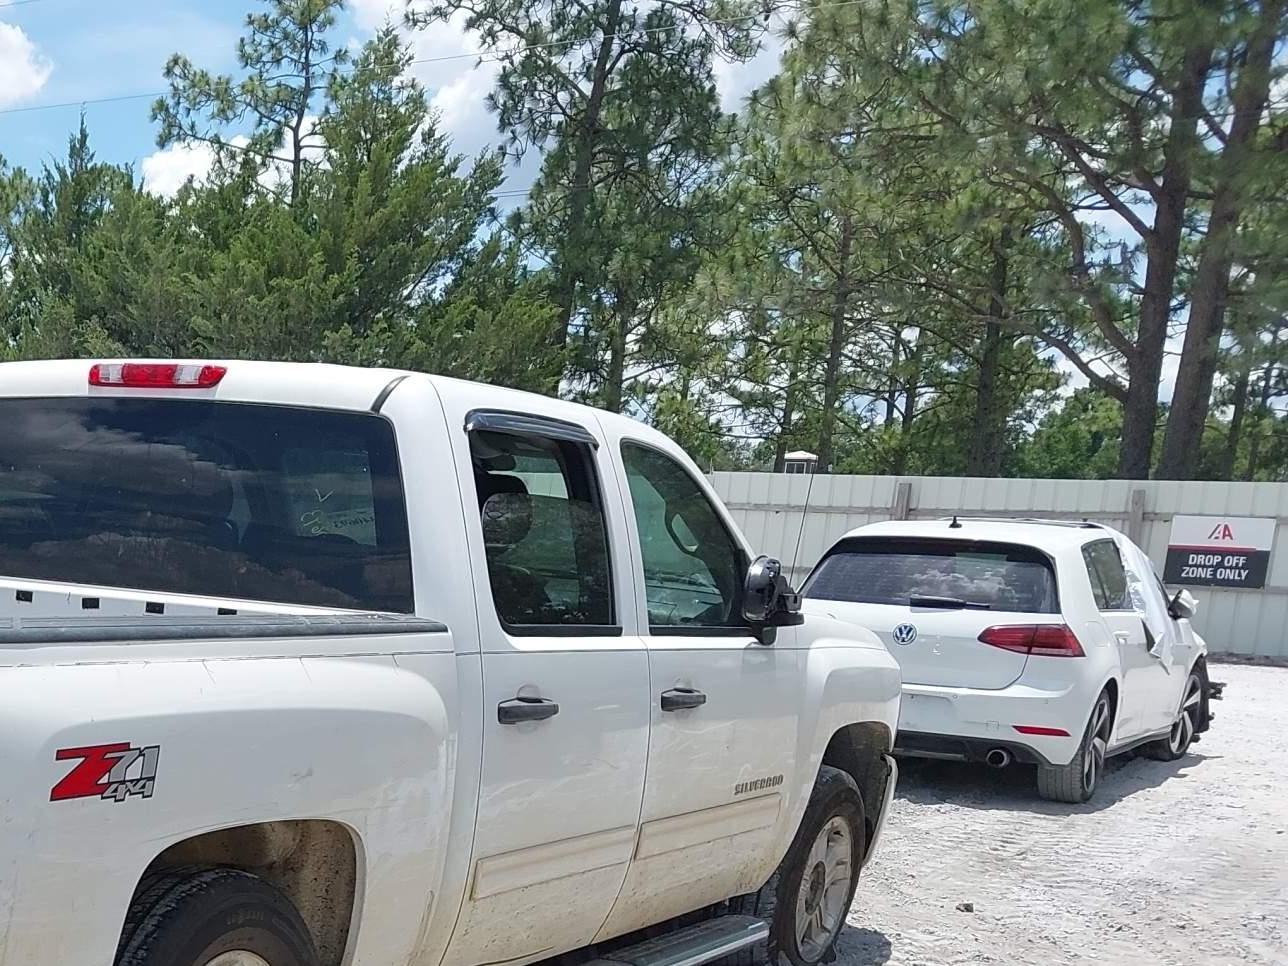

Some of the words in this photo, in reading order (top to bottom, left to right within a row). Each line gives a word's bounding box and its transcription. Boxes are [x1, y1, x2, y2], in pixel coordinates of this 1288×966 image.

[1188, 554, 1221, 566] DROP
[1224, 555, 1247, 568] OFF
[1181, 566, 1214, 579] ZONE
[1216, 568, 1249, 580] ONLY
[49, 742, 160, 802] Z71
[734, 774, 783, 796] SILVERADO
